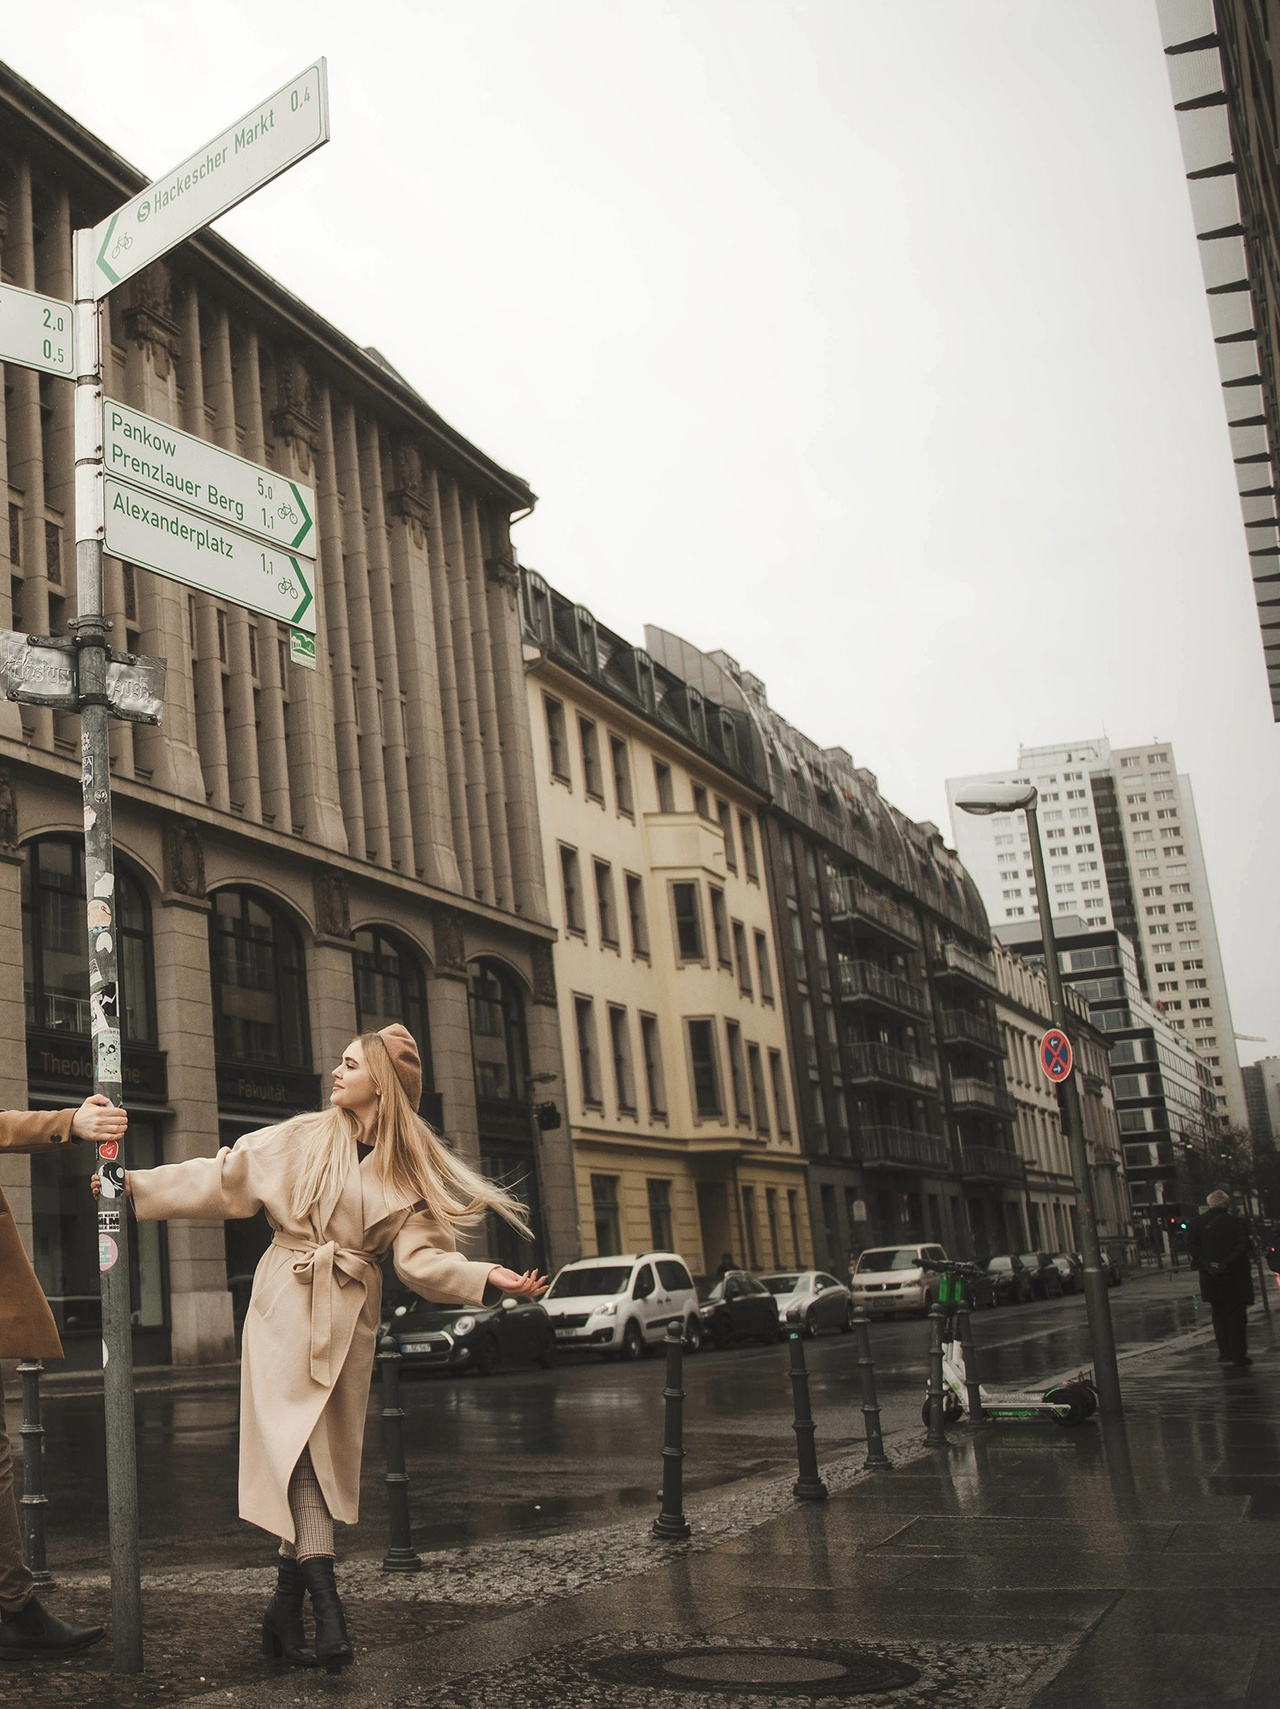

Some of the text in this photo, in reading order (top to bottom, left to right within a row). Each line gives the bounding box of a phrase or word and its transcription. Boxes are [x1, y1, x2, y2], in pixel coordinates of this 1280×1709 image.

[154, 147, 227, 213] Hackescher
[234, 109, 275, 154] Markt
[43, 308, 64, 332] 2,0
[43, 339, 64, 363] 0,5
[112, 412, 273, 500] Pankow 5,0
[112, 443, 274, 530] Prenzlauer Berg 1,1
[113, 492, 274, 575] Alexanderplatz 1,1
[40, 1051, 140, 1084] Theolohe
